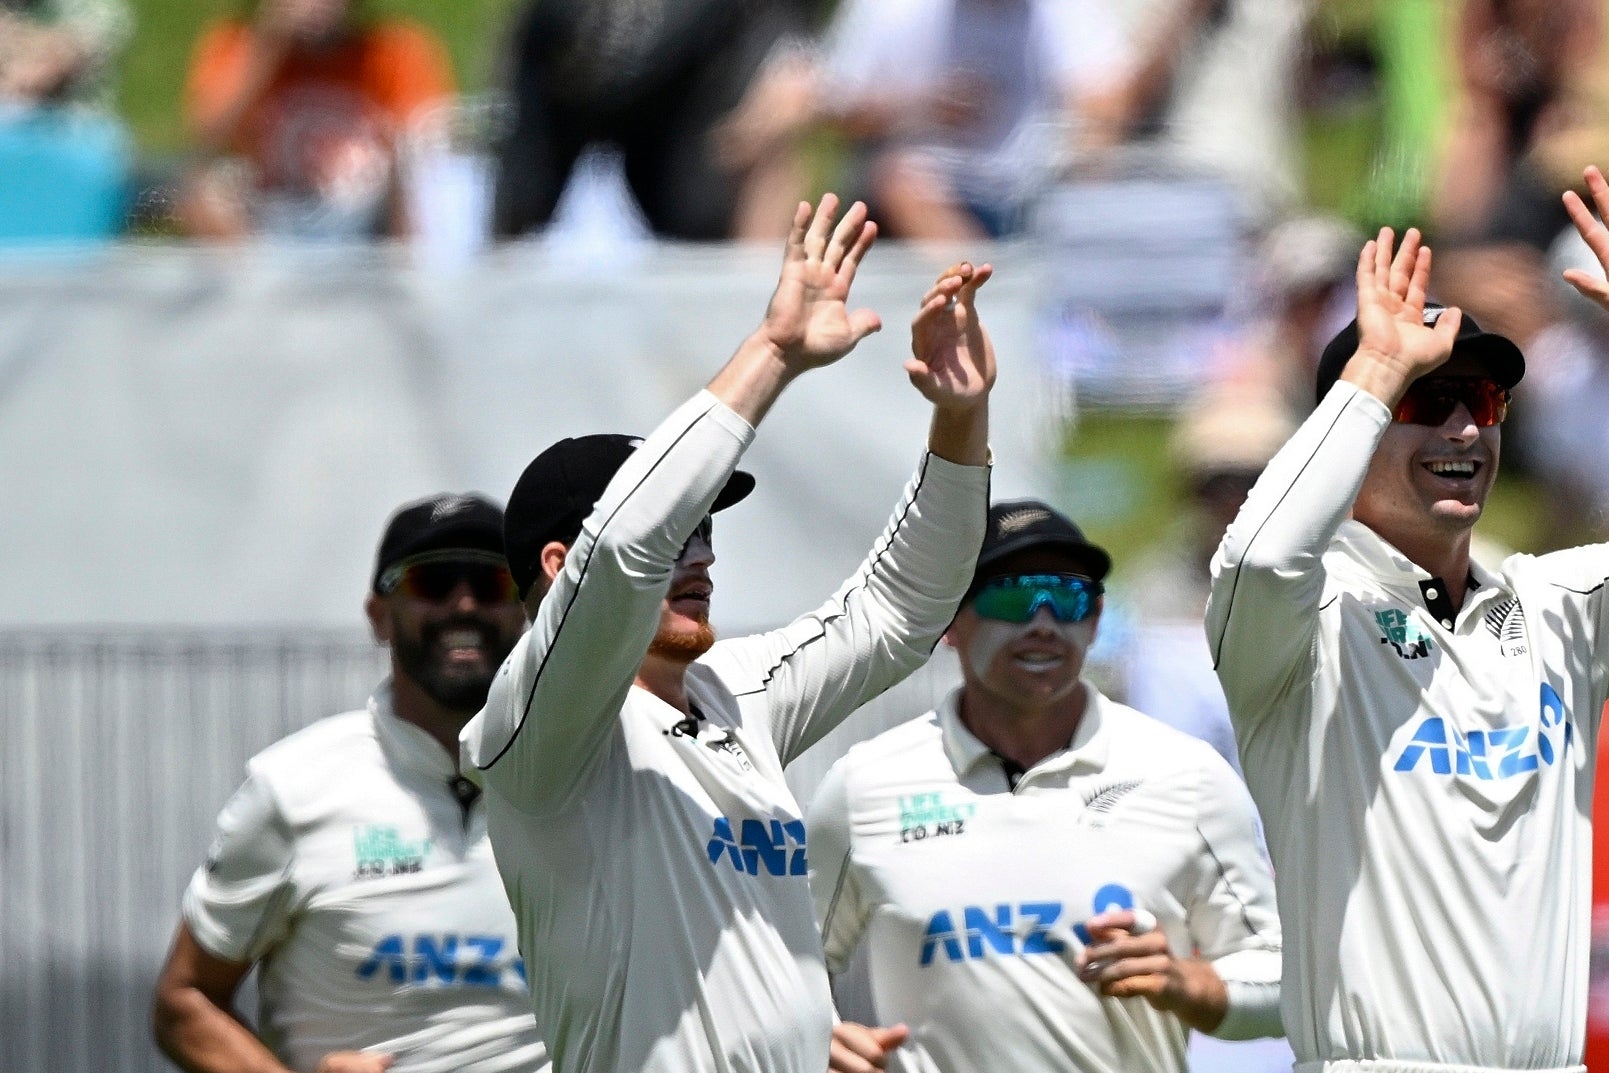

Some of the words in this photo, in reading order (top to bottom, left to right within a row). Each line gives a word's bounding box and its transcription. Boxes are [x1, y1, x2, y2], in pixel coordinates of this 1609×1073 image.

[1510, 645, 1527, 657] 280
[1394, 717, 1538, 781] ANZ
[355, 934, 504, 986] ANZ
[920, 902, 1064, 968] ANZ
